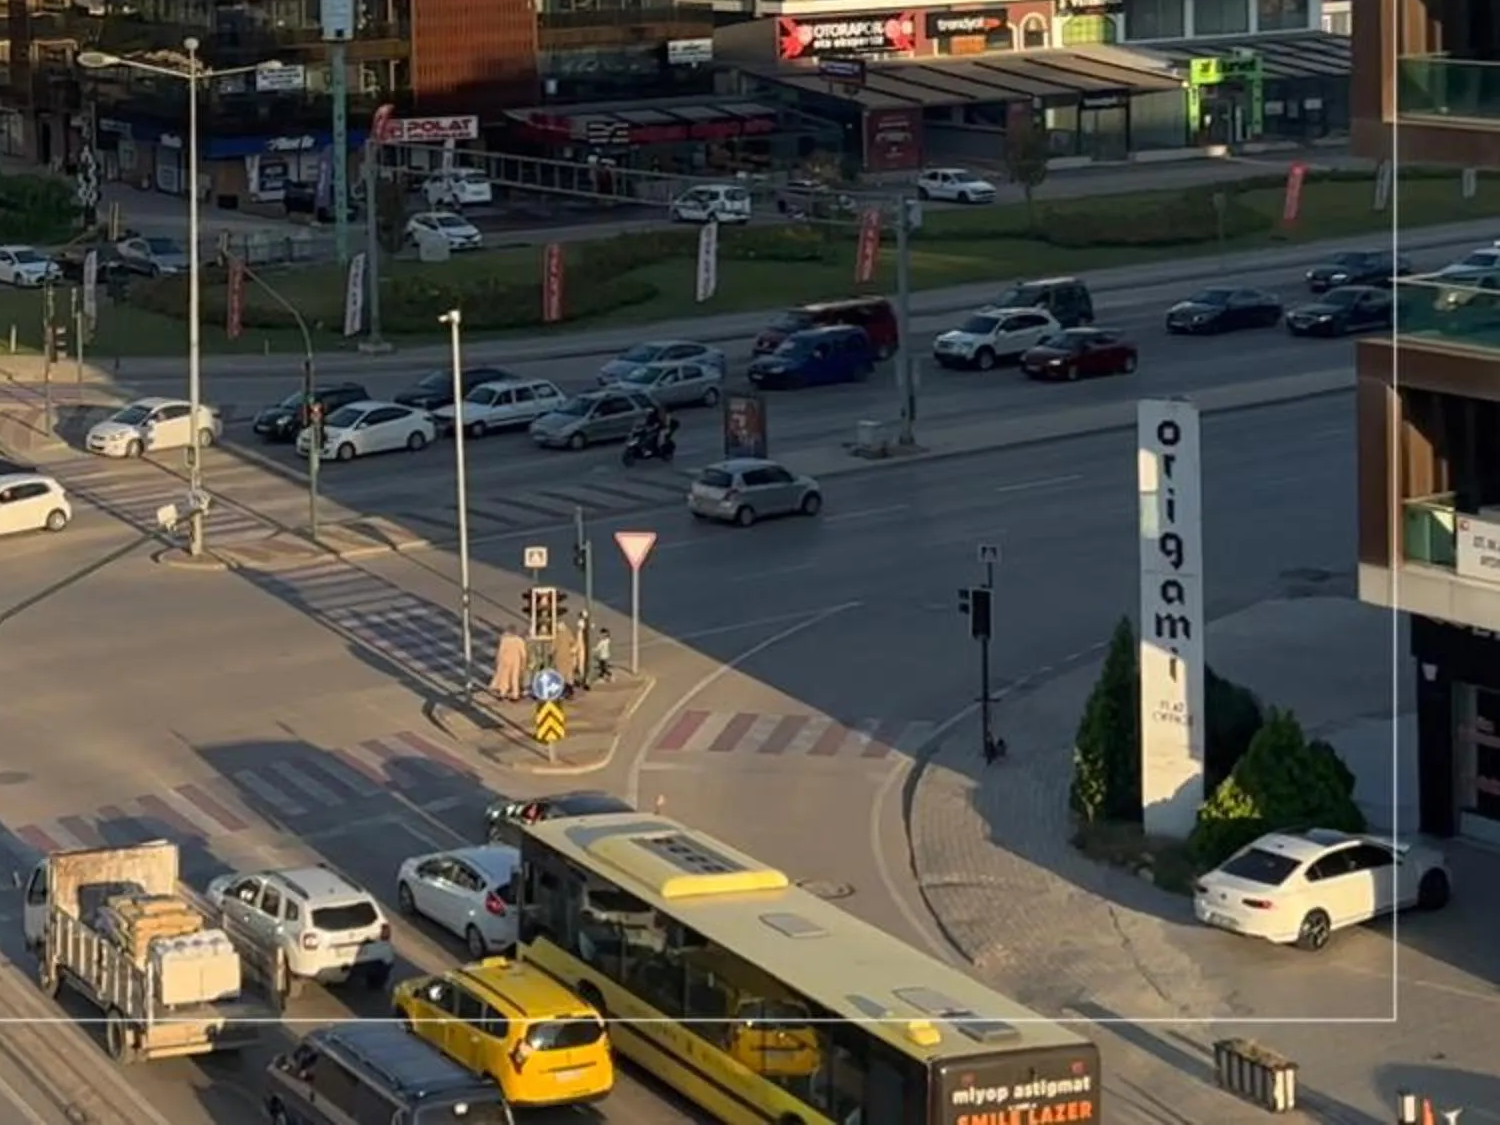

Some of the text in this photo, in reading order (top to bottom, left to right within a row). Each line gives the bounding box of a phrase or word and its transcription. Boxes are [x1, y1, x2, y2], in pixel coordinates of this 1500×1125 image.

[1155, 420, 1192, 683] origami
[952, 1076, 1091, 1106] miyop astigmat
[1028, 1100, 1093, 1125] LAZER
